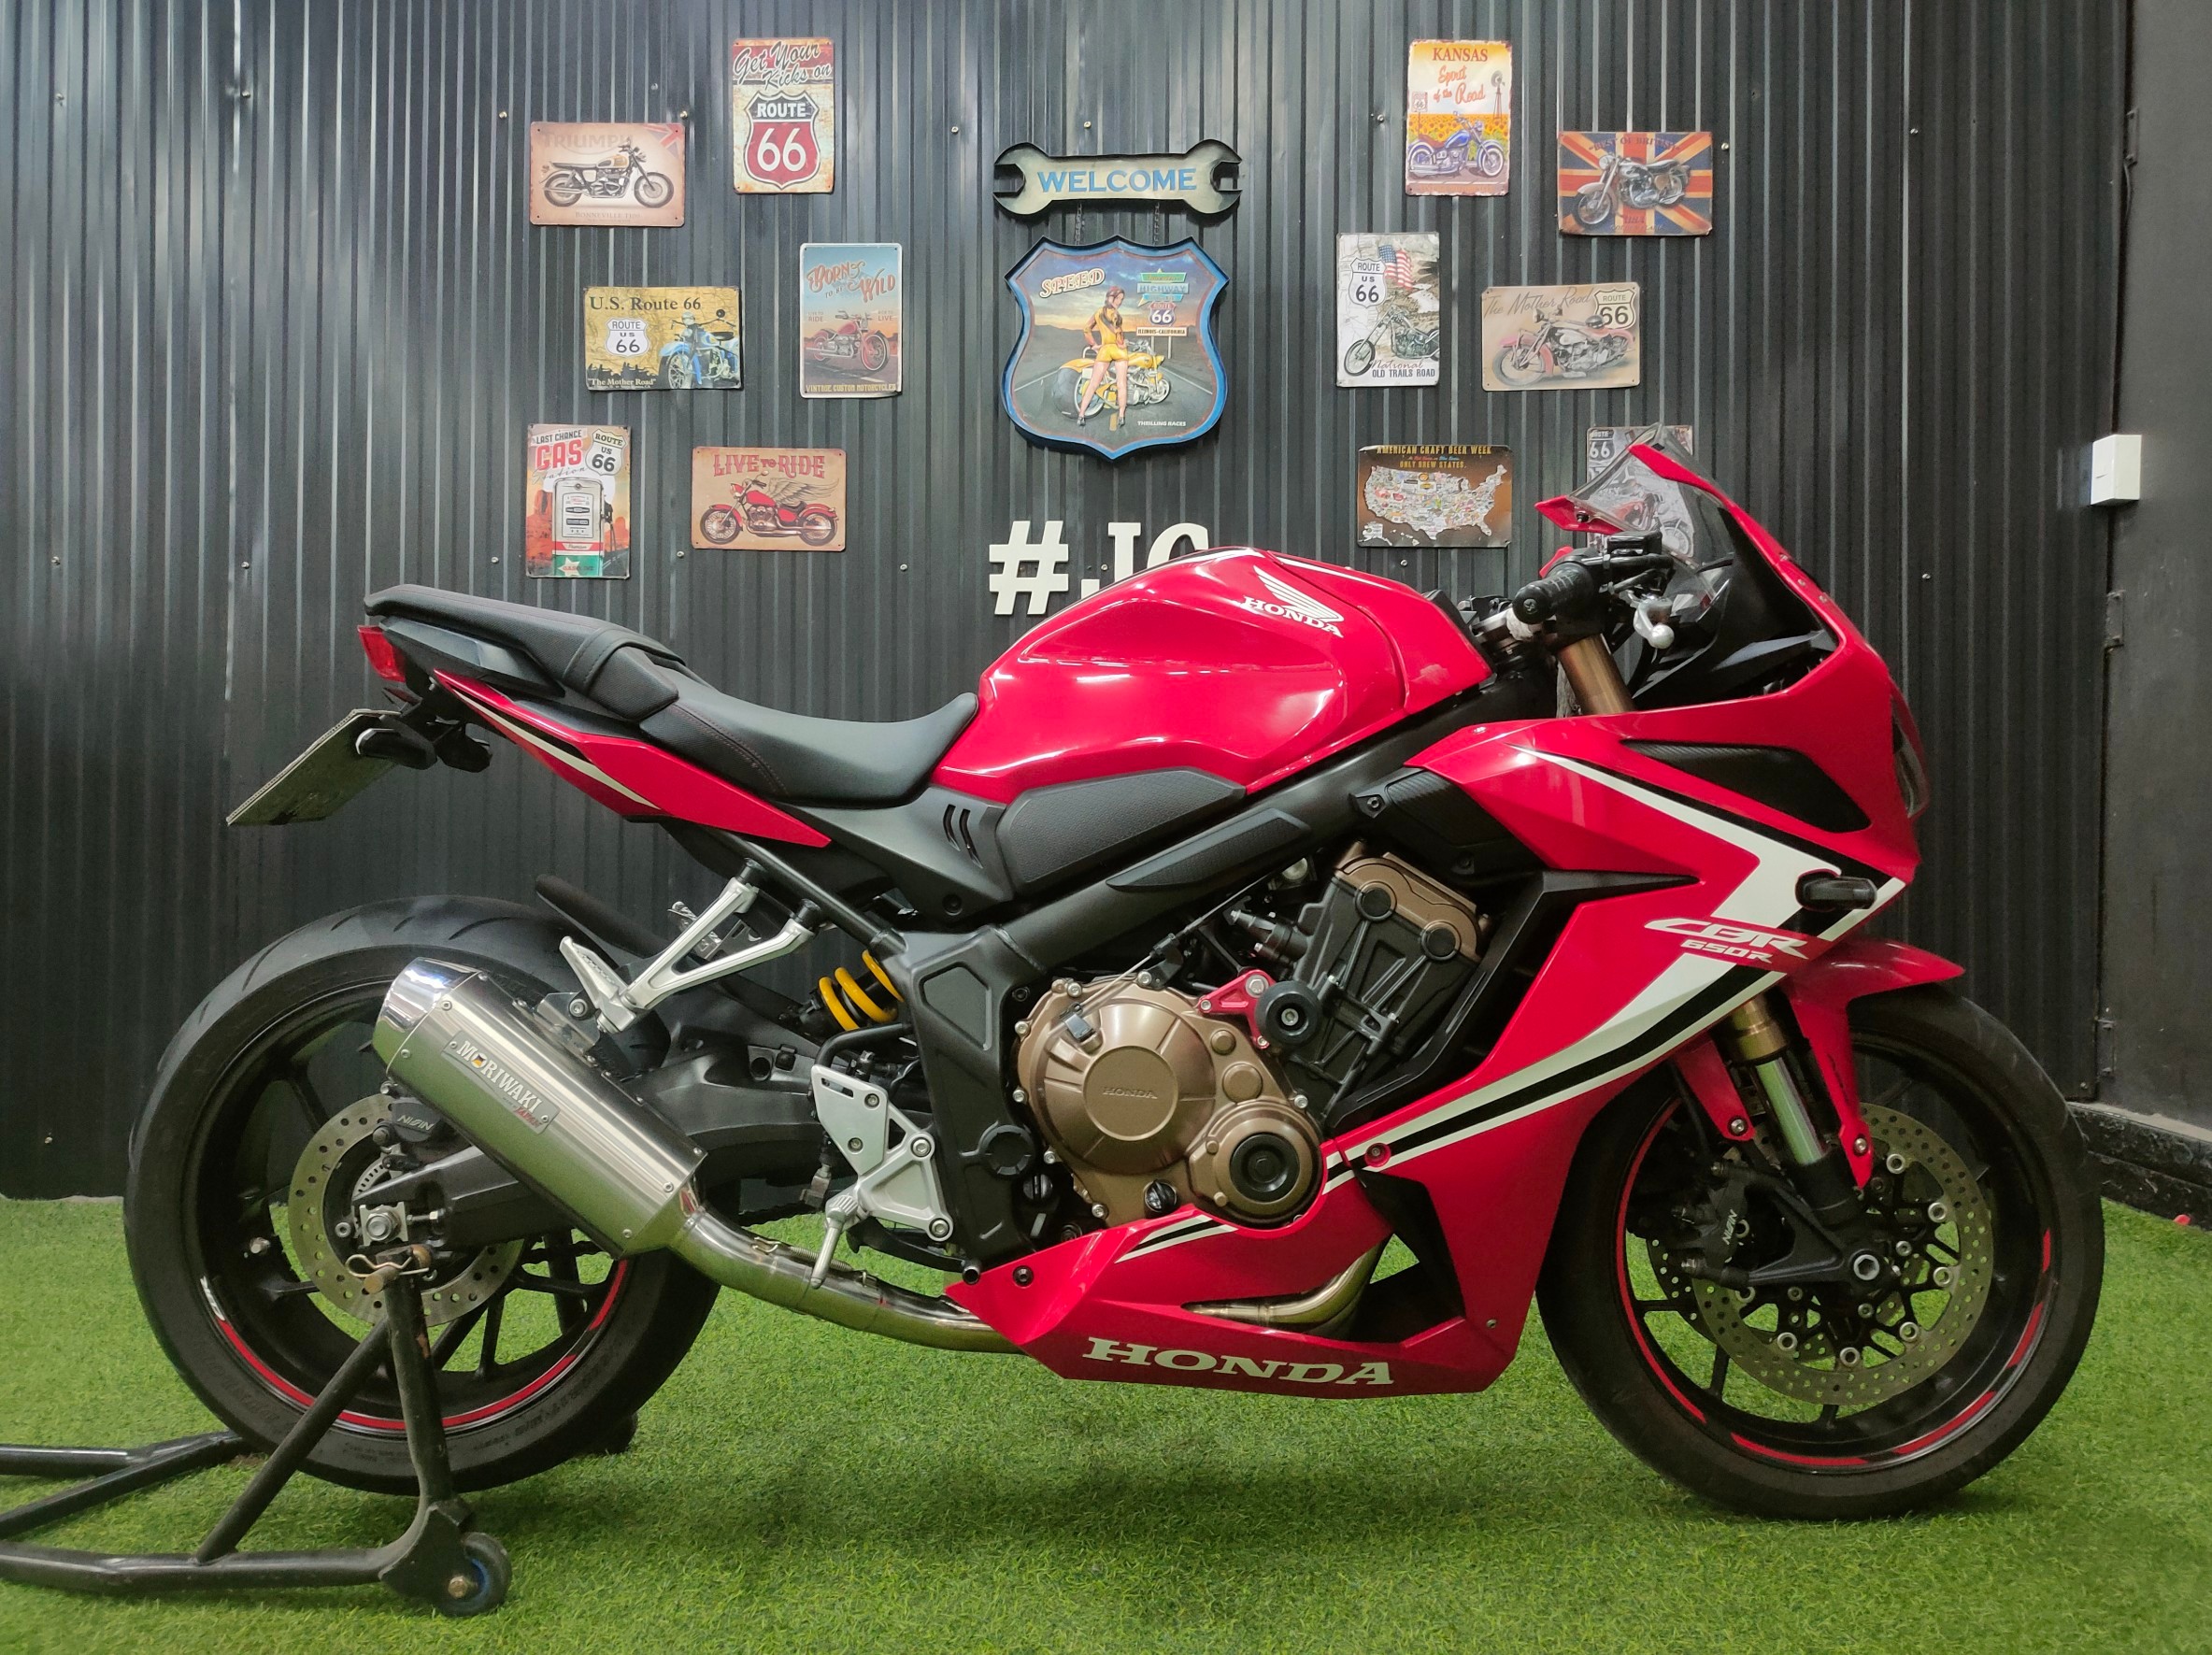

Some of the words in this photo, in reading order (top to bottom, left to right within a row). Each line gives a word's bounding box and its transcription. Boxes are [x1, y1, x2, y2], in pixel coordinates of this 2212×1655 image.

[734, 48, 767, 84] Get
[771, 41, 820, 70] Your
[1432, 47, 1489, 62] KANSAS
[763, 64, 807, 91] Kicks
[814, 64, 832, 78] on
[1438, 64, 1467, 86] Spirit
[1433, 90, 1442, 102] of
[1442, 88, 1452, 99] the
[1455, 82, 1485, 105] Road
[756, 103, 806, 117] ROUTE
[540, 133, 634, 149] TRIUMPH
[756, 128, 806, 172] 66
[1036, 168, 1197, 193] WELCOME
[806, 261, 866, 292] BORN
[1357, 263, 1380, 272] ROUTE
[848, 268, 896, 303] WILD
[1039, 267, 1106, 298] SPEED
[1140, 284, 1185, 292] HIGHWAY
[589, 296, 624, 310] U.S.
[631, 296, 678, 310] Route
[683, 297, 701, 310] 66
[1356, 284, 1379, 303] 66
[1507, 291, 1557, 316] Mother
[1561, 286, 1594, 308] Road
[612, 321, 641, 329] ROUTE
[1152, 309, 1172, 323] 66
[1599, 306, 1629, 325] 66
[616, 339, 640, 353] 66
[1370, 358, 1423, 370] National
[1372, 370, 1385, 378] OLD
[1389, 369, 1413, 378] TRAILS
[1417, 368, 1435, 378] ROAD
[607, 378, 635, 386] Mother
[536, 435, 552, 444] LAST
[555, 430, 581, 441] CHANCE
[595, 433, 622, 446] ROUTE
[536, 438, 582, 471] GAS
[601, 447, 612, 455] US
[1377, 446, 1417, 454] AMERICAN
[1420, 446, 1445, 454] CRAFT
[1449, 446, 1467, 454] BEER
[1470, 446, 1491, 454] WEEK
[1590, 441, 1610, 458] 66
[592, 453, 616, 472] 66
[714, 454, 759, 477] LIVE
[778, 455, 825, 478] RIDE
[1242, 595, 1344, 638] HONDA
[1644, 917, 1809, 960] CBR
[1680, 939, 1774, 964] 650R
[456, 1040, 543, 1115] MORIWAKI
[1102, 1086, 1158, 1100] HONDA
[1082, 1336, 1394, 1386] HONDA
